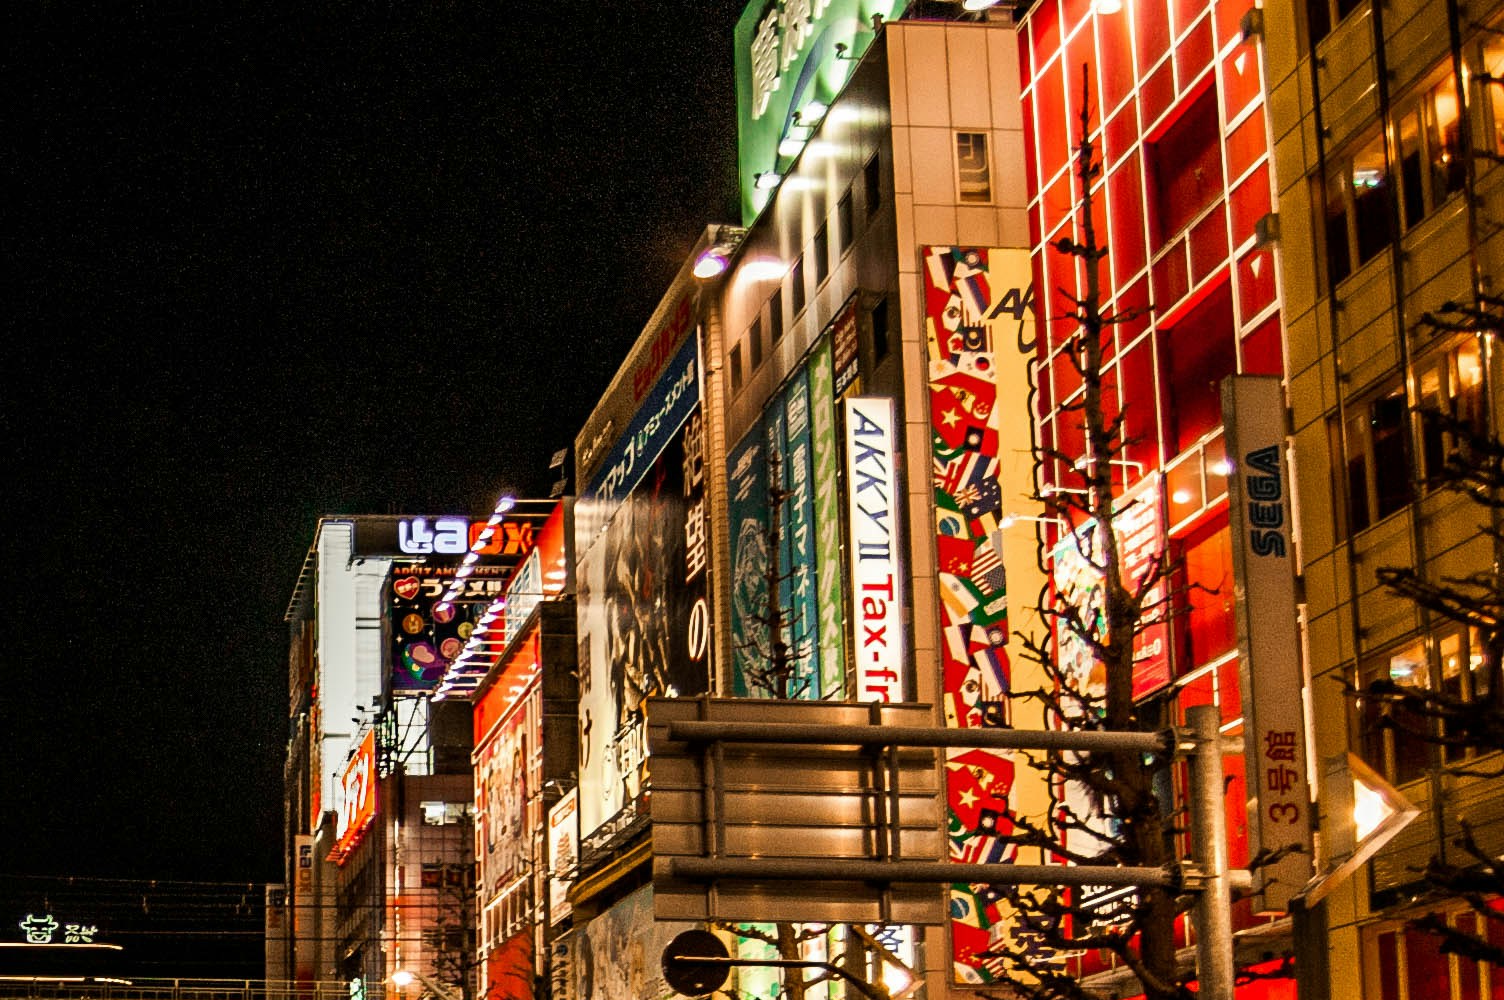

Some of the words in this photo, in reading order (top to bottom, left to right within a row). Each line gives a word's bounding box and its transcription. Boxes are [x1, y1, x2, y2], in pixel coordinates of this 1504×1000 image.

[851, 407, 893, 536] AKKY
[1245, 444, 1287, 559] SEGA
[1263, 730, 1300, 826] 3号館
